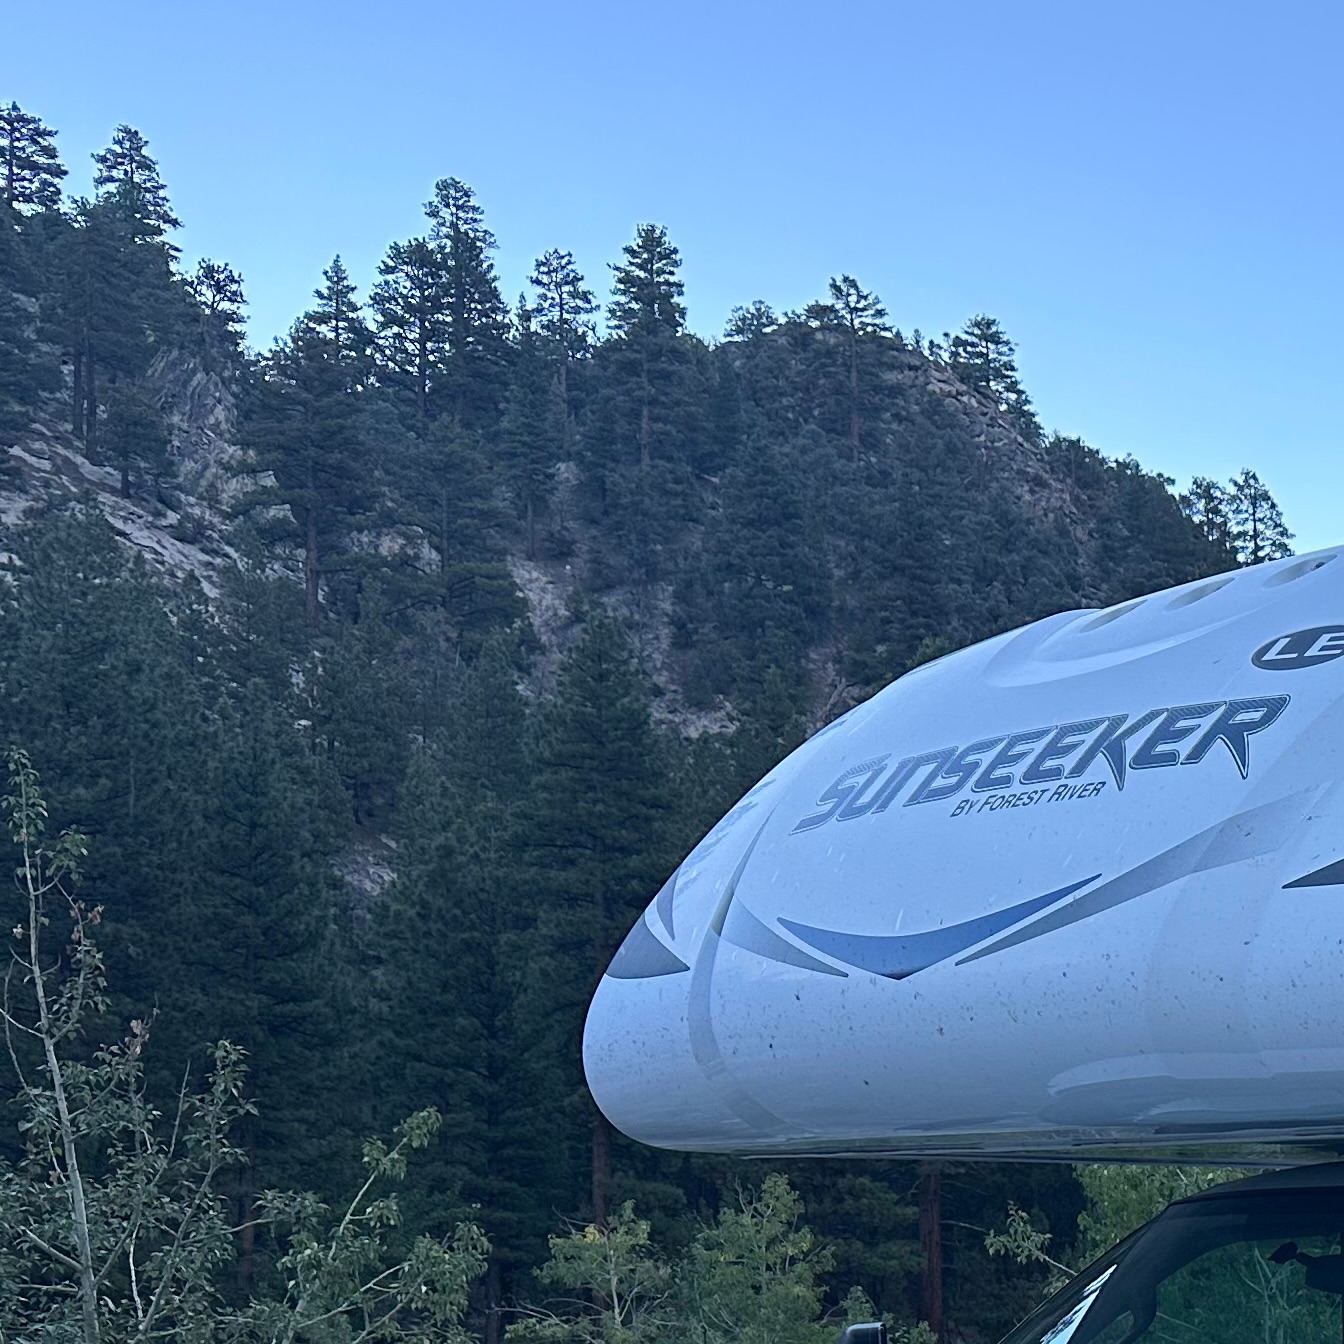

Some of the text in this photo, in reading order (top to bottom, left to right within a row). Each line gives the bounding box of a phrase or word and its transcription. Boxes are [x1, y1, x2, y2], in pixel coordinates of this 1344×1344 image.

[790, 694, 1292, 836] SUNSEEKER
[950, 781, 1107, 818] BY FOREST RIVER
